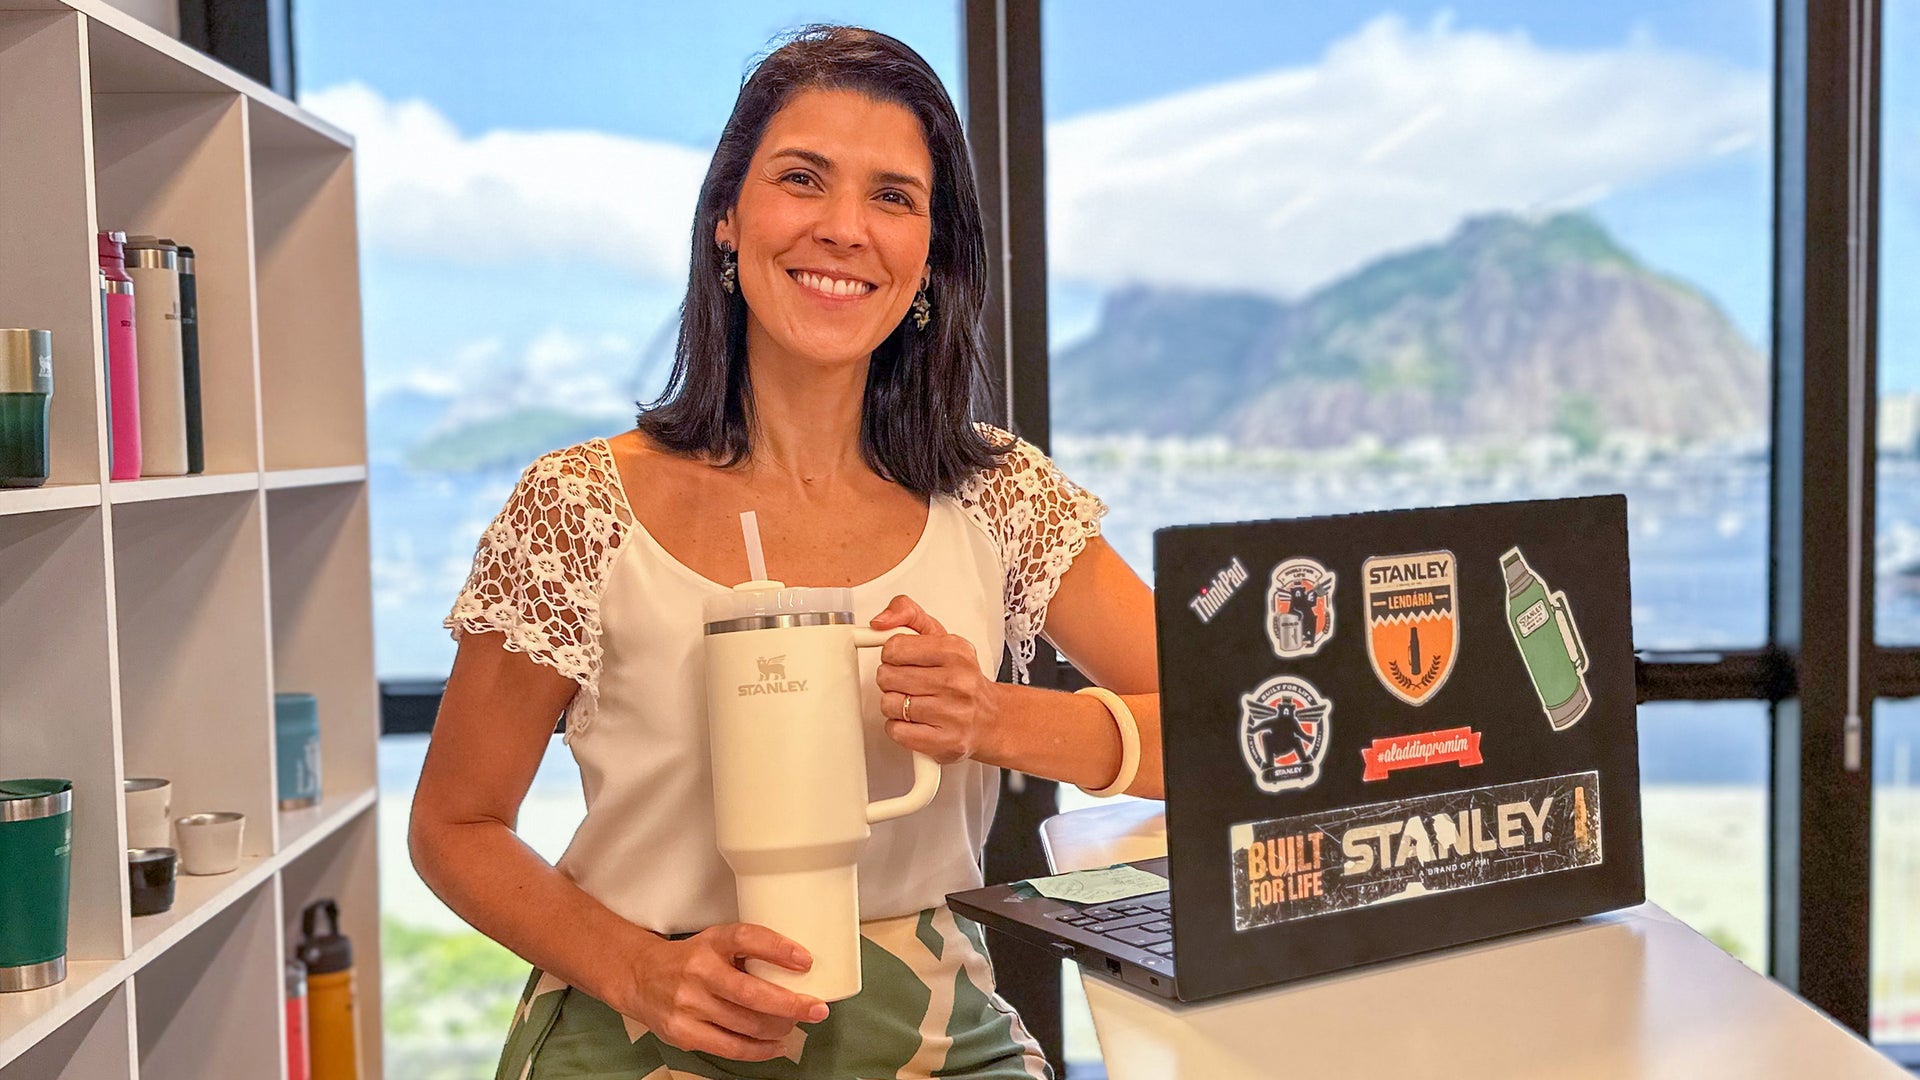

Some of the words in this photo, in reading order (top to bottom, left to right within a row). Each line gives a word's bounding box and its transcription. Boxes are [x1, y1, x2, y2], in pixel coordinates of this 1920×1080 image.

[1369, 560, 1448, 585] STANLEY
[1190, 557, 1248, 622] ThinkPad
[1388, 591, 1434, 610] LENDÁRIA
[738, 680, 808, 697] STANLEY
[1261, 685, 1281, 701] BUILT
[1298, 689, 1313, 702] LIFE
[1377, 734, 1468, 763] #aladdinpramim
[1274, 766, 1303, 777] STANLEY
[1342, 797, 1554, 876] STANLEY
[1248, 831, 1324, 881] BUILT
[1427, 864, 1458, 876] BRAND
[1460, 861, 1472, 870] OF
[1249, 878, 1285, 908] FOR
[1287, 871, 1324, 901] LIFE
